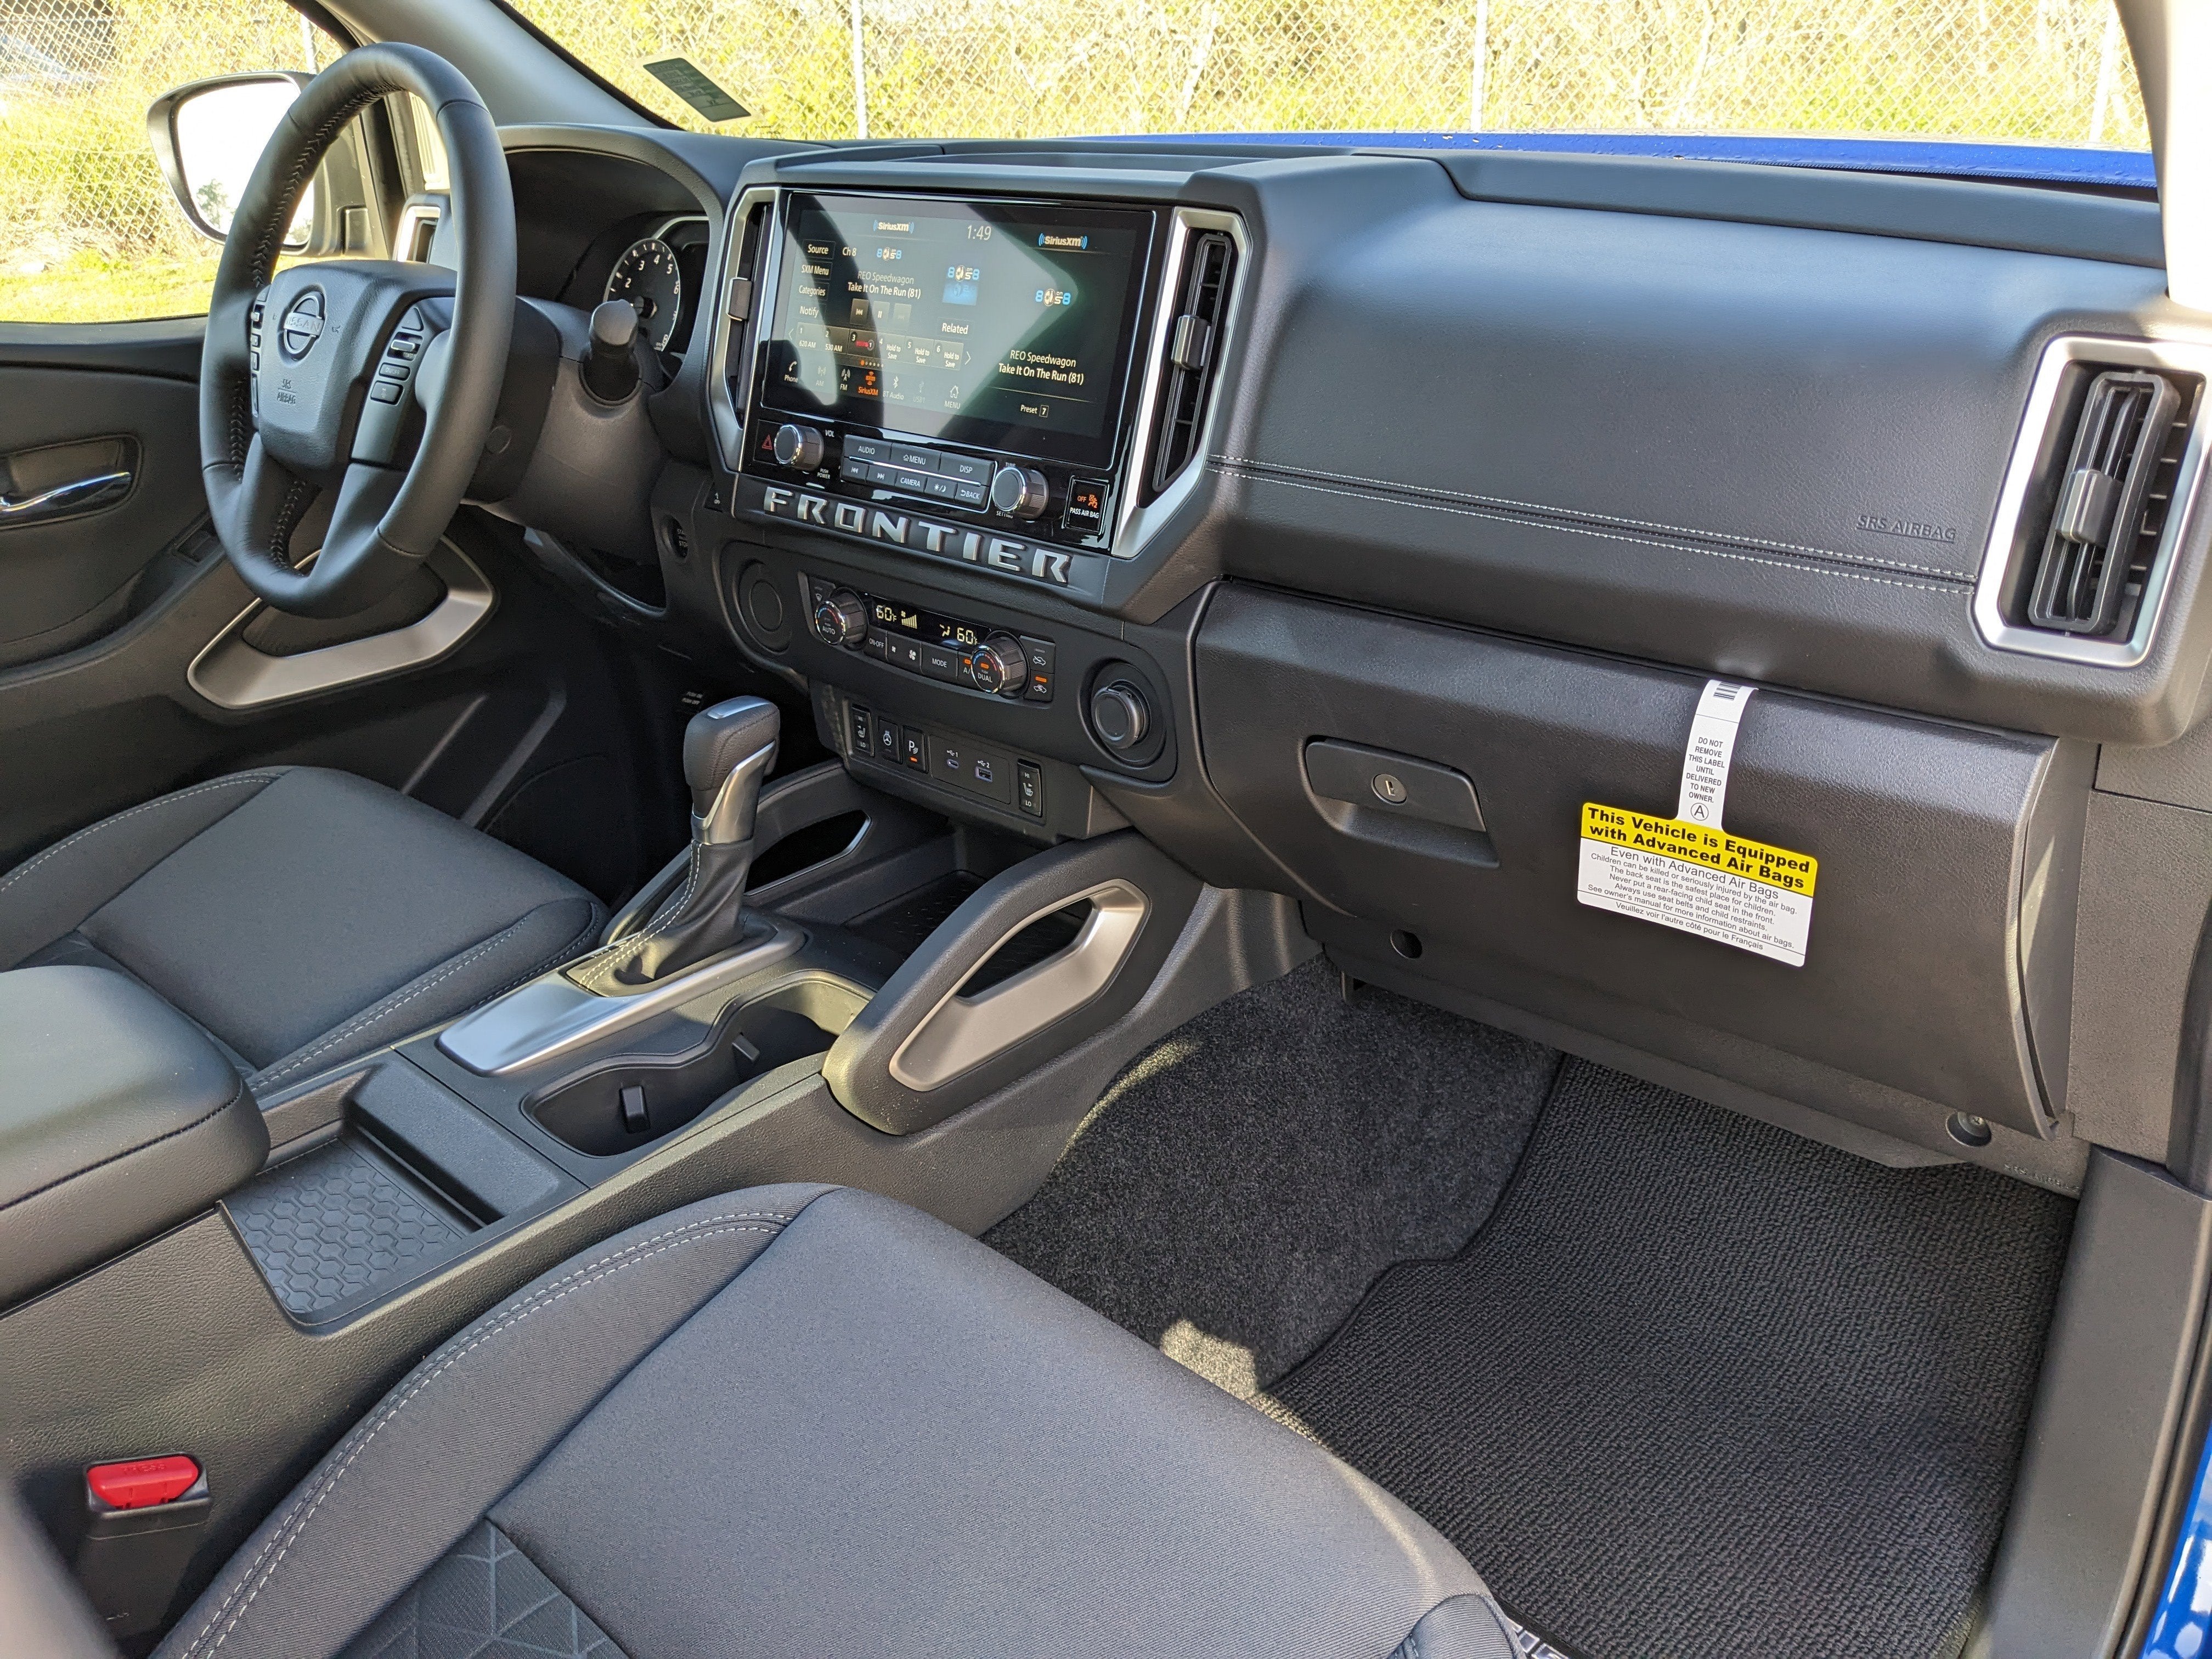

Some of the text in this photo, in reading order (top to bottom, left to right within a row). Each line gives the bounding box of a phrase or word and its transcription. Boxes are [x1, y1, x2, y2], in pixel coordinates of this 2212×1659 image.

[968, 225, 991, 240] 1:49
[808, 244, 828, 254] Source
[842, 247, 856, 256] Ch 8
[639, 260, 645, 270] 3
[654, 255, 660, 264] 4
[667, 264, 673, 274] 5
[802, 264, 829, 275] SXM Menu
[625, 278, 631, 288] 2
[857, 271, 914, 285] REO Speedwagon
[799, 285, 826, 296] Categories
[848, 282, 862, 292] Take
[870, 285, 878, 294] On
[881, 286, 891, 295] The
[894, 287, 906, 296] Run
[907, 288, 921, 299] (81)
[800, 306, 819, 318] Notify
[942, 323, 969, 335] Related
[1010, 350, 1076, 368] REO Speedwagon
[785, 374, 798, 383] Phone
[998, 363, 1084, 385] Take It On The Run (81)
[858, 386, 878, 396] SiriusXM
[890, 392, 904, 400] Audio
[944, 400, 961, 409] MENU
[1020, 404, 1037, 414] Preset
[858, 445, 875, 455] AUDIO
[910, 457, 926, 465] MENU
[960, 465, 973, 474] DISP
[900, 477, 921, 487] CAMERA
[966, 491, 980, 500] BACK
[1070, 507, 1081, 516] PASS
[1856, 515, 1956, 540] SRS AIRBAG
[764, 486, 1072, 583] FRONTIER
[822, 626, 836, 635] AUTO
[932, 658, 947, 668] MODE
[978, 673, 992, 683] DUAL
[1709, 739, 1723, 748] NOT
[1695, 746, 1722, 758] REMOVE
[1689, 754, 1725, 768] THIS LABEL
[1696, 765, 1714, 775] UNTIL
[1686, 772, 1722, 786] DELIVERED
[1700, 785, 1715, 794] NEW
[1689, 792, 1714, 803] OWNER.
[1588, 807, 1810, 873] This Vehicle is Equipped
[1589, 825, 1804, 888] with Advanced Air Bags
[1611, 846, 1779, 899] Even with Advanced Air Bags
[1591, 853, 1621, 866] Children
[1650, 867, 1669, 877] killed
[1681, 876, 1714, 890] seriously
[1716, 884, 1741, 897] injured
[1743, 890, 1752, 901] by
[1755, 895, 1767, 905] the
[1769, 900, 1779, 908] air
[1781, 904, 1797, 915] bag.
[1610, 865, 1624, 874] The
[1626, 869, 1643, 879] back
[1645, 875, 1661, 883] seat
[1685, 884, 1707, 896] safest
[1709, 890, 1729, 902] place
[1732, 896, 1742, 906] for
[1744, 900, 1775, 916] children.
[1610, 873, 1631, 884] Never
[1633, 879, 1645, 888] put
[1654, 884, 1693, 902] rear-facing
[1695, 895, 1712, 905] child
[1714, 901, 1730, 911] seat
[1733, 905, 1739, 914] in
[1741, 908, 1753, 917] the
[1755, 912, 1774, 925] front.
[1615, 883, 1768, 931] Always use seat belts and child restraints.
[1588, 884, 1602, 893] See
[1604, 890, 1632, 901] owner's
[1634, 896, 1661, 908] manual
[1675, 908, 1694, 917] more
[1696, 912, 1737, 930] information
[1739, 926, 1759, 938] about
[1762, 933, 1771, 941] air
[1774, 936, 1795, 949] bags.
[1616, 901, 1644, 914] Veuillez
[1661, 914, 1683, 925] l'autre
[1685, 921, 1701, 930] côté
[1703, 927, 1720, 937] pour
[1731, 934, 1763, 950] Français
